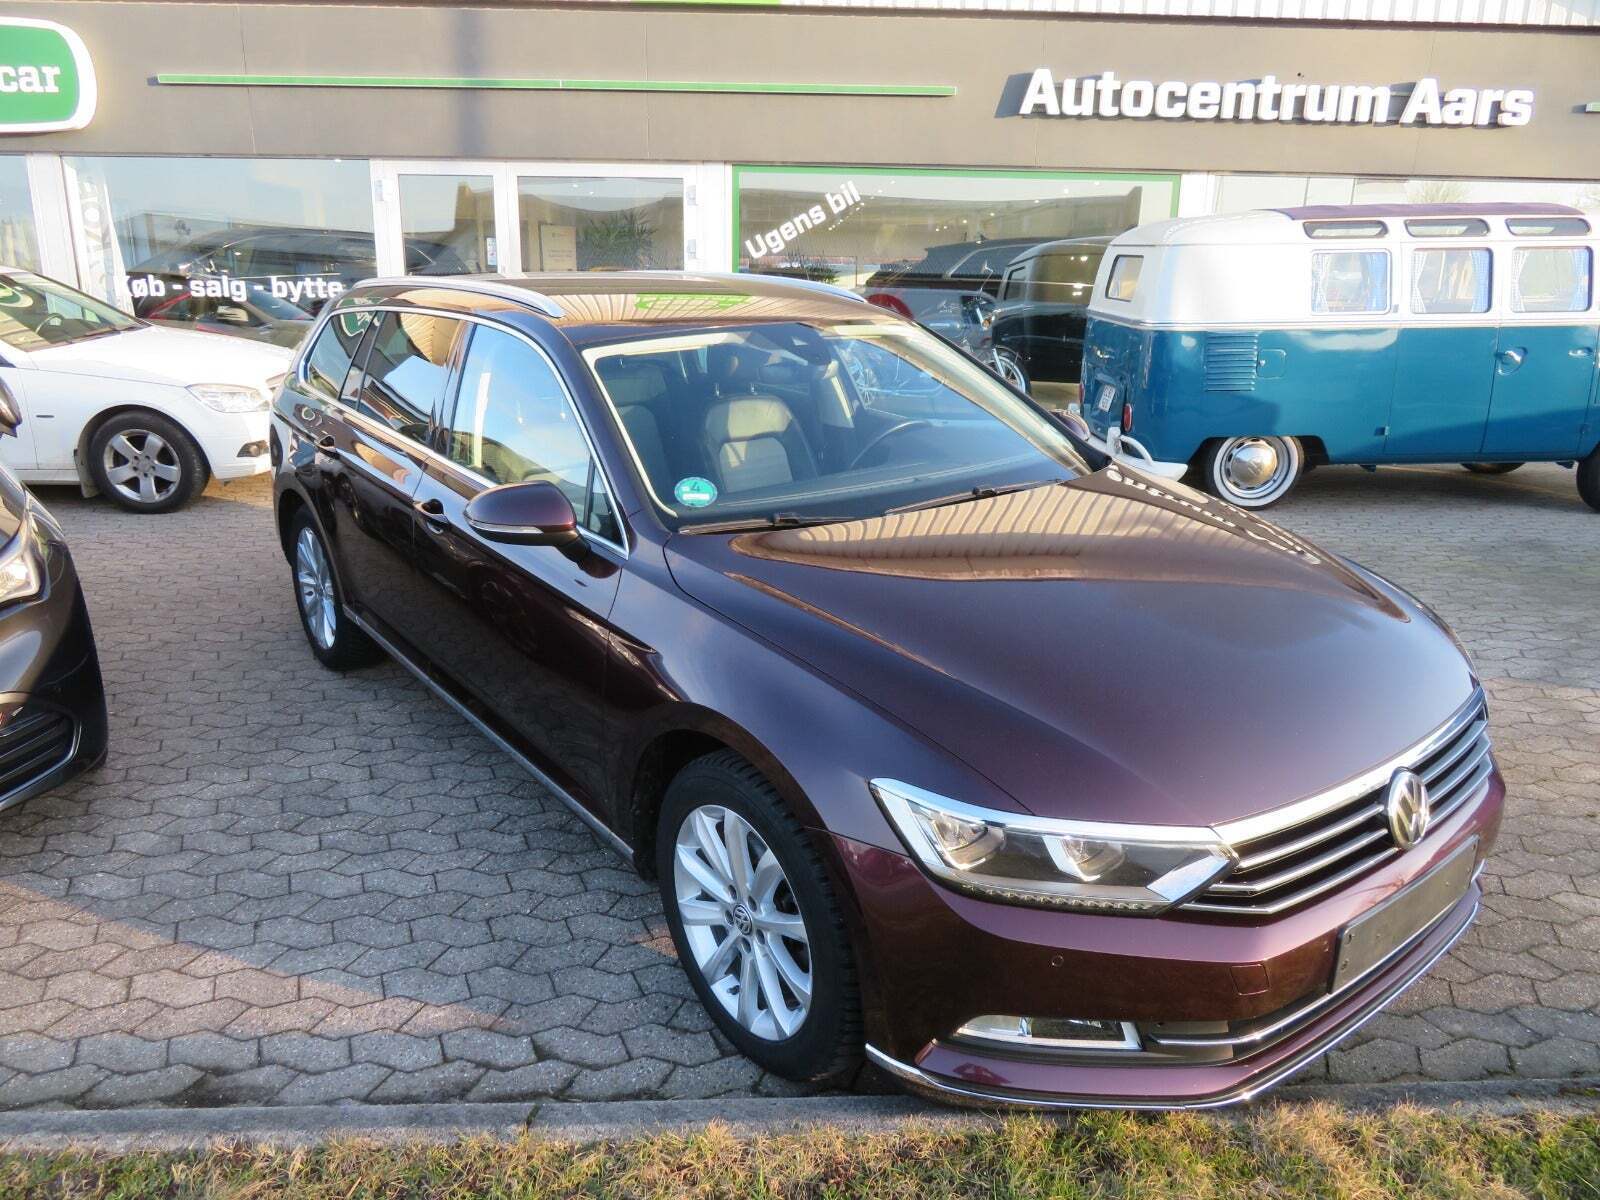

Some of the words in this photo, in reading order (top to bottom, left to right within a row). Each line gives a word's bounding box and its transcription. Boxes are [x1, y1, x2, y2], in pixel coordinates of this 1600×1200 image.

[1019, 68, 1391, 123] Autocentrum
[1399, 77, 1535, 126] Aars
[745, 204, 827, 259] Ugens
[825, 180, 861, 214] bil
[190, 275, 247, 302] salg
[271, 276, 343, 303] bytte
